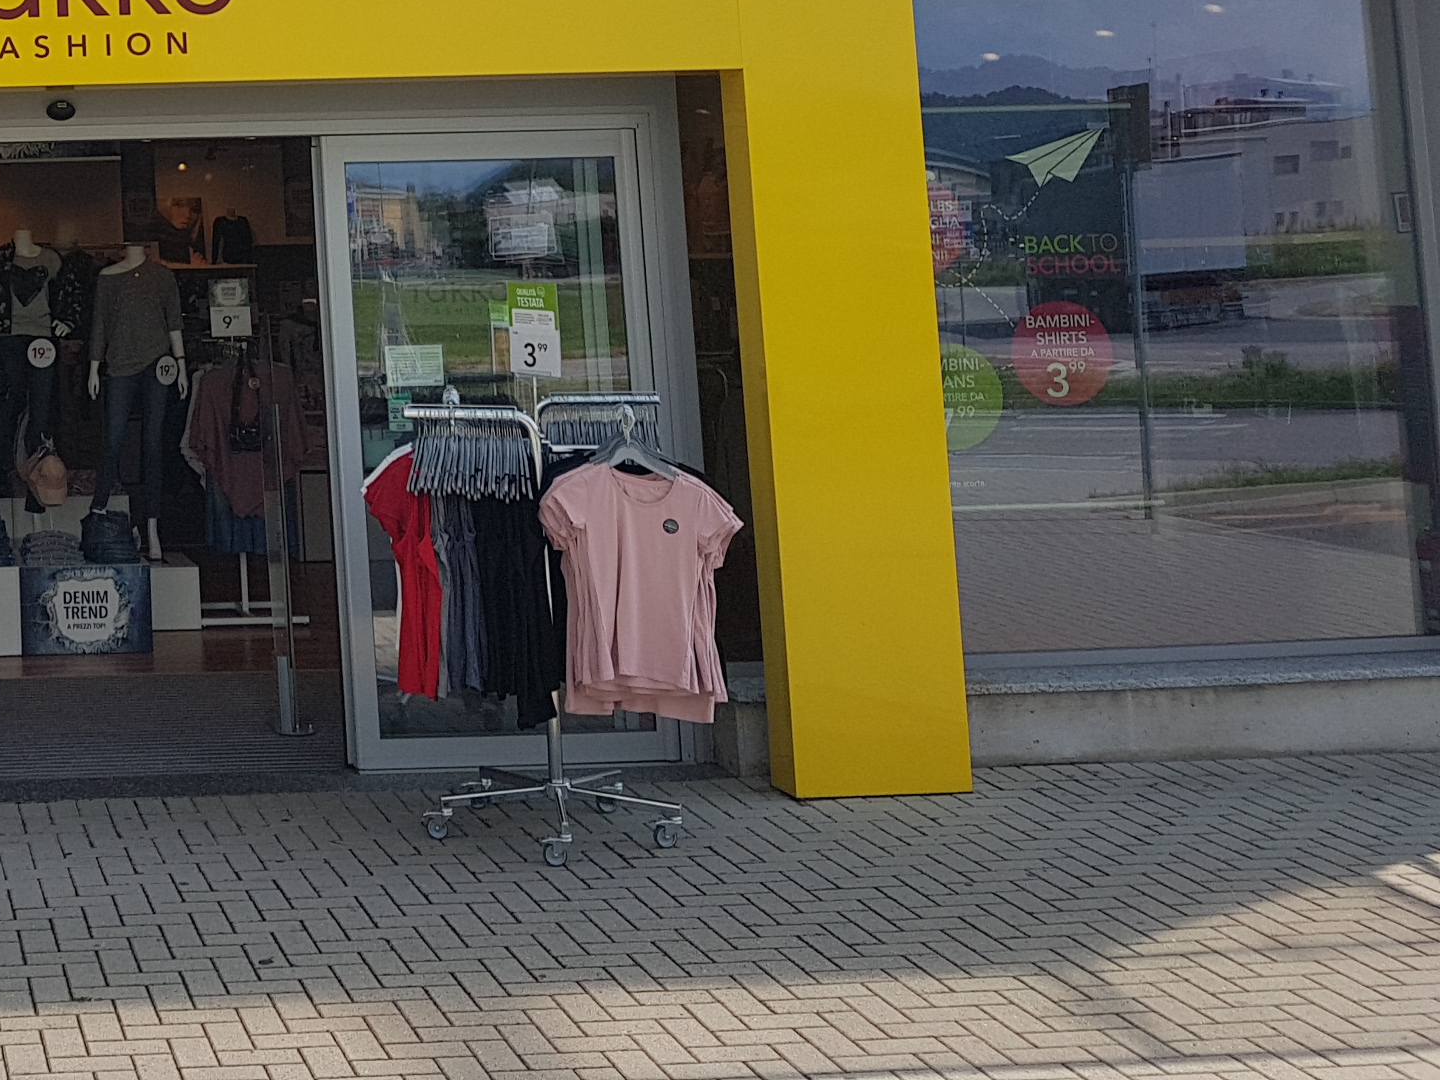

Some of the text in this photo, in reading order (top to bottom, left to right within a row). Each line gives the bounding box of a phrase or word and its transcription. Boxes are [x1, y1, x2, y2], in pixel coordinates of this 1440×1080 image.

[1024, 233, 1117, 254] BACK TO
[1027, 254, 1121, 275] SCHOOL
[516, 297, 545, 308] TESTATA
[1026, 313, 1095, 328] BAMBINI-
[1036, 331, 1088, 345] SHIRTS
[1031, 347, 1095, 358] A PARTIRE DA
[970, 391, 985, 402] DA
[63, 590, 109, 605] DENIM
[63, 606, 109, 620] TREND
[73, 623, 92, 631] PREZZI
